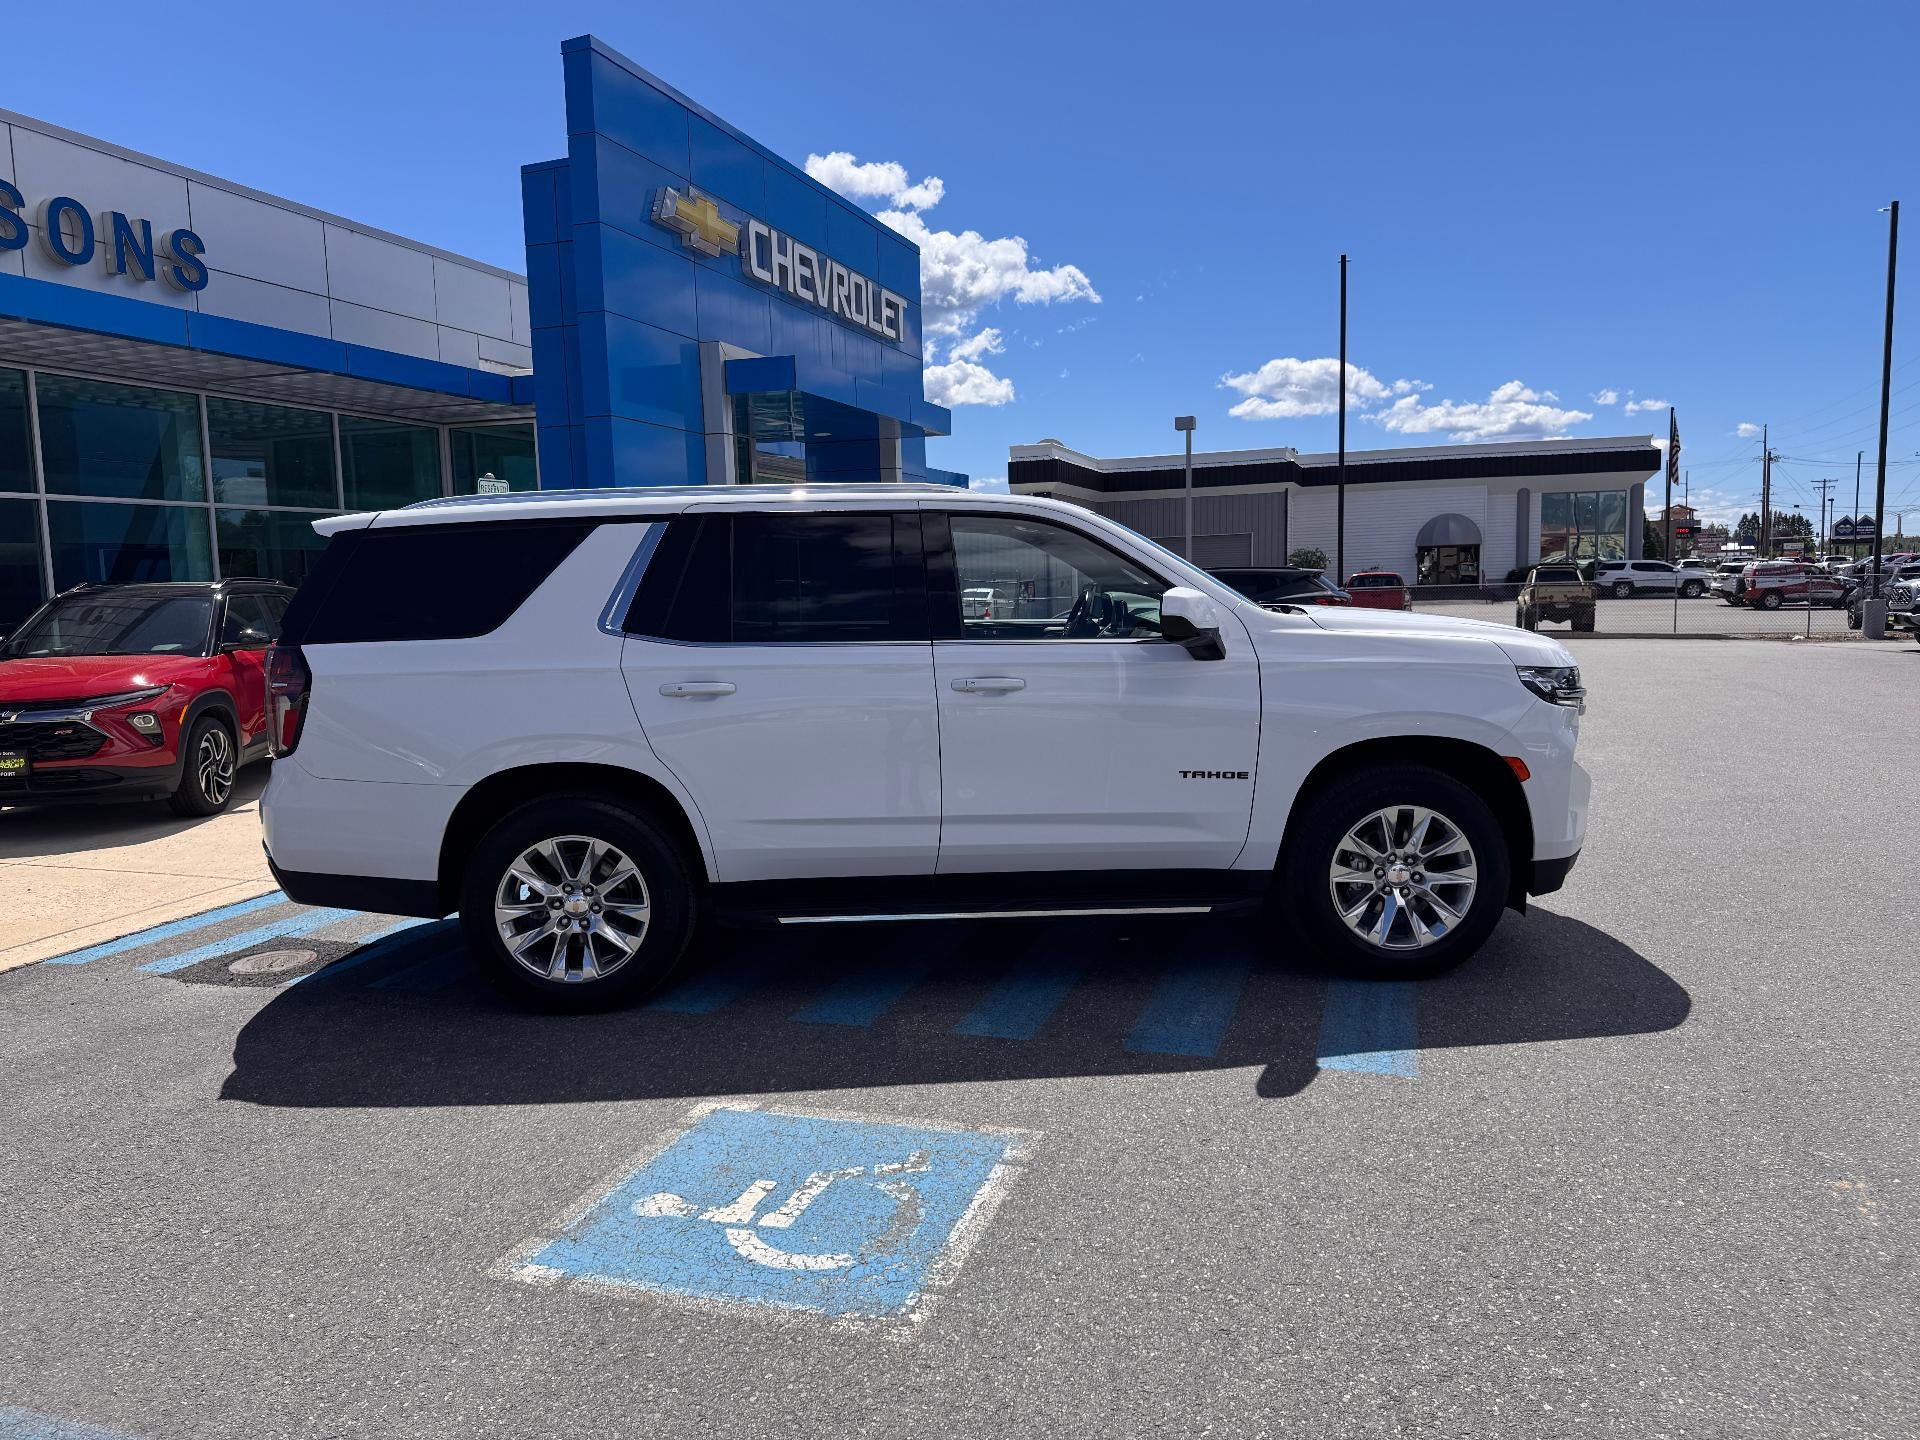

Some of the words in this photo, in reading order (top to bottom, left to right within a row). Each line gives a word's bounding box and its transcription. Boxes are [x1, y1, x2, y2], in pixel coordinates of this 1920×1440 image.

[0, 178, 208, 292] SONS
[747, 218, 908, 343] CHEVROLET
[1178, 770, 1249, 780] TAHOE
